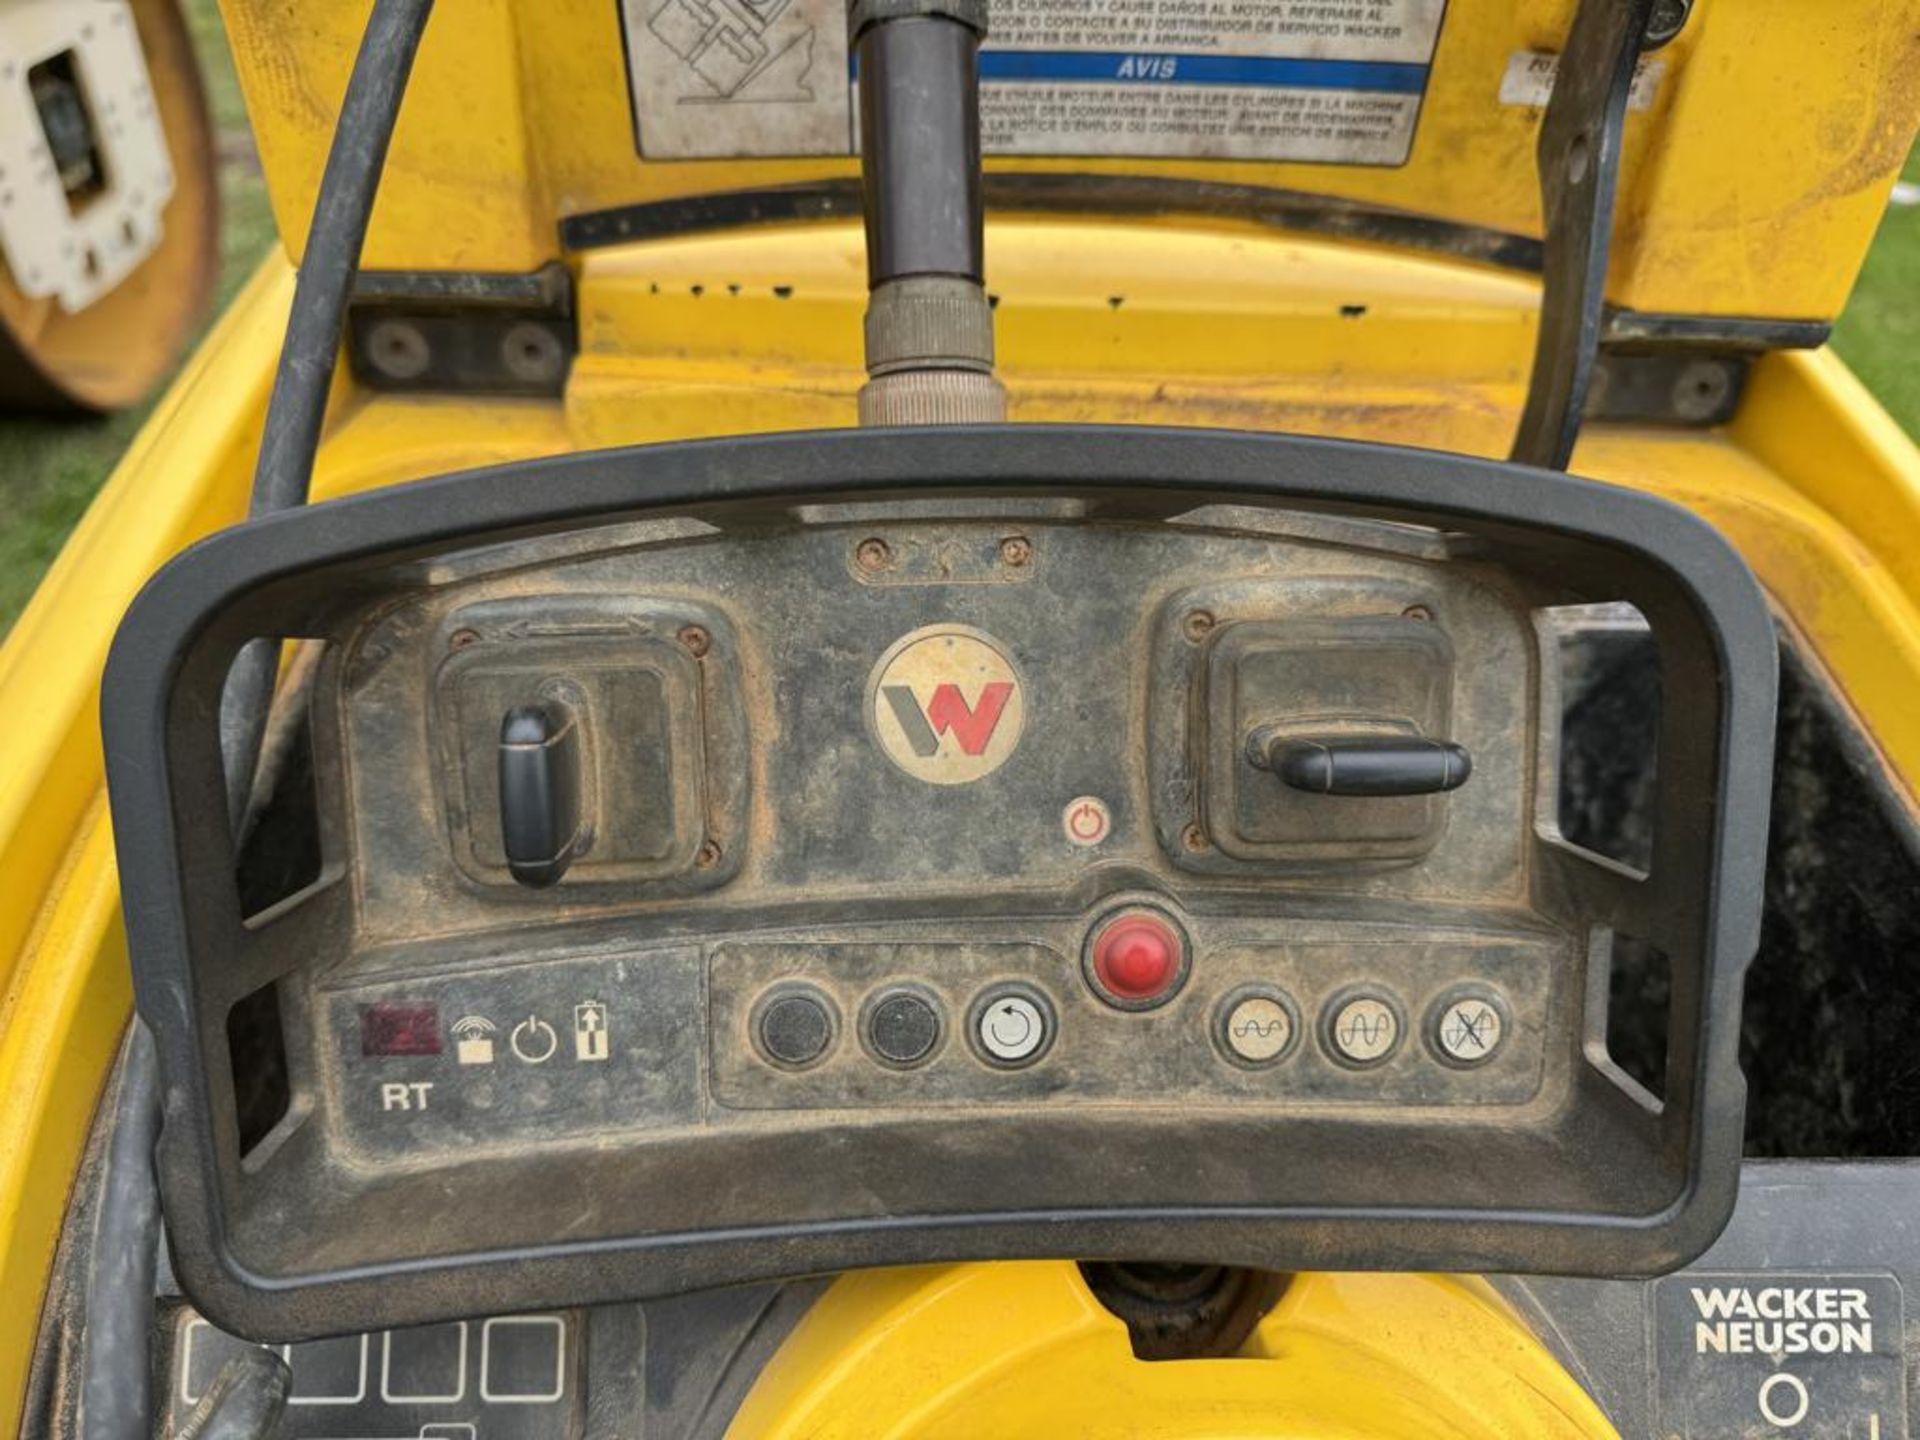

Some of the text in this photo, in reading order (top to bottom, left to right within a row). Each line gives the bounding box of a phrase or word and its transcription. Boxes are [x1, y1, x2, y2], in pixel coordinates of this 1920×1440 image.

[1211, 3, 1227, 16] AL
[1116, 56, 1177, 79] AVIS
[382, 1082, 433, 1111] RT
[1690, 1287, 1871, 1319] WACKER
[1695, 1321, 1872, 1353] NEUSON
